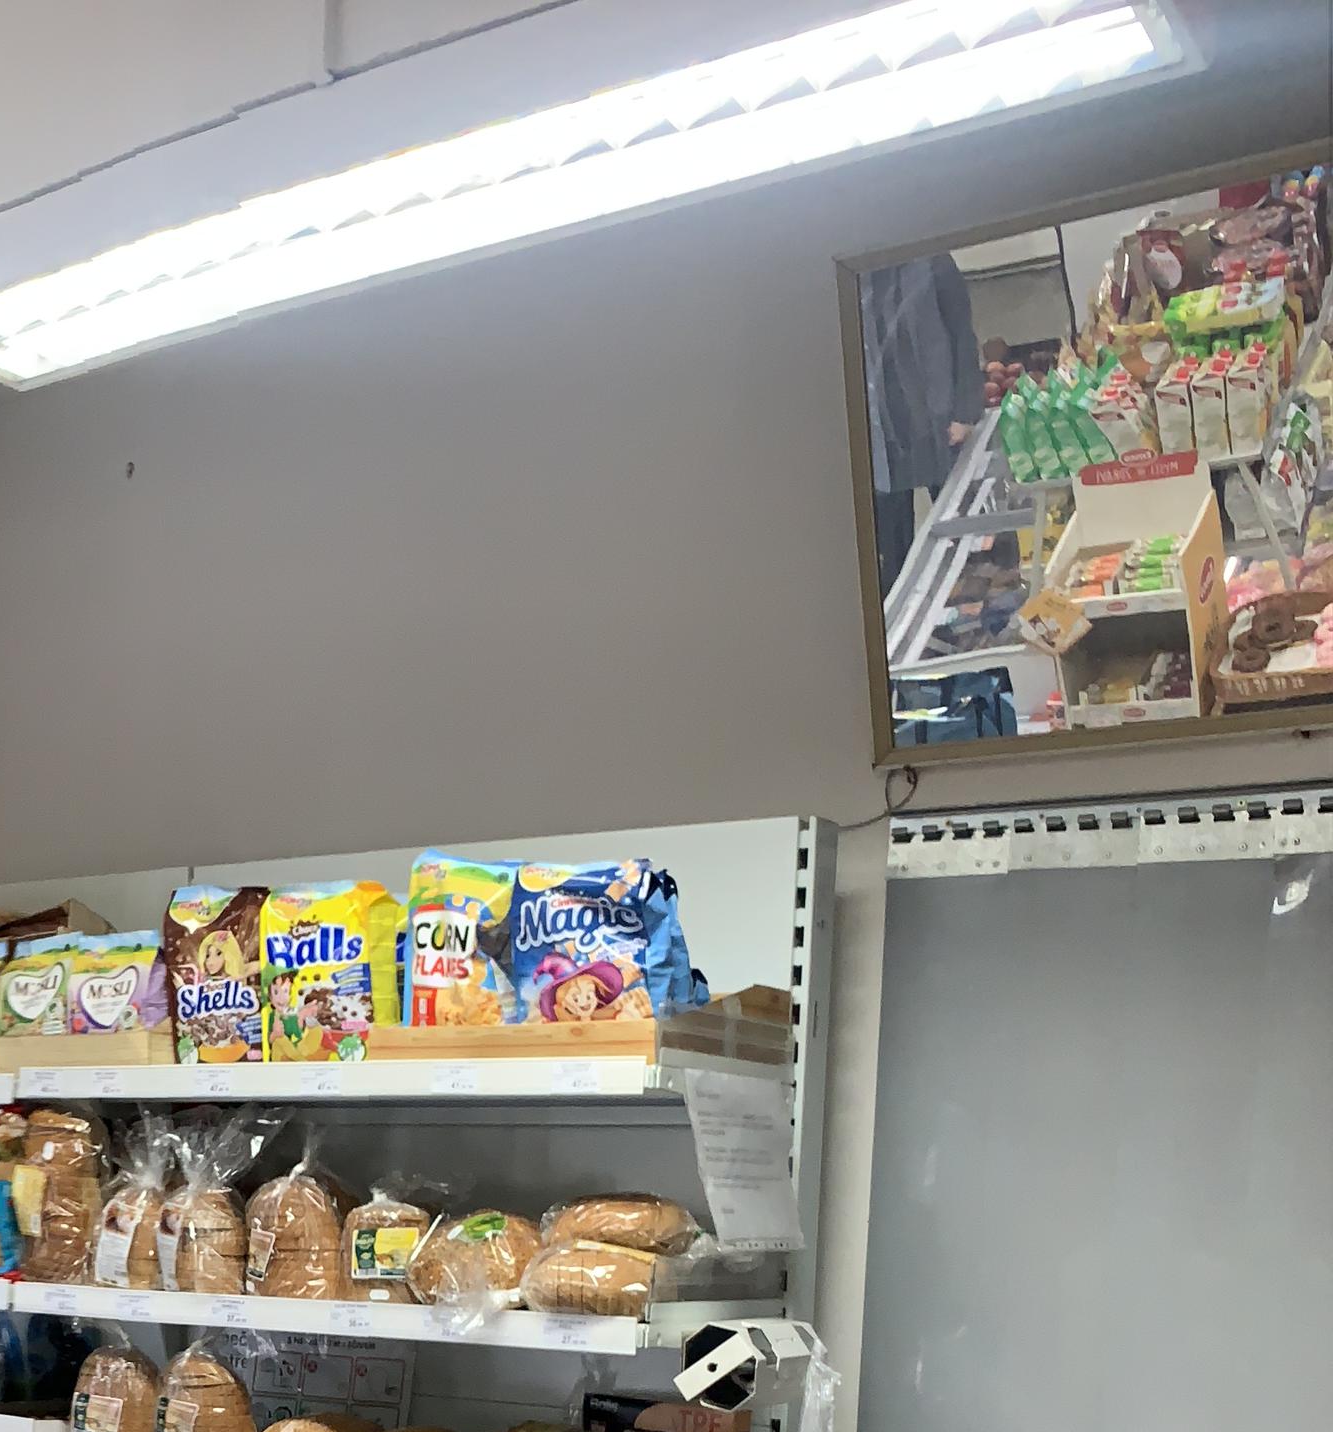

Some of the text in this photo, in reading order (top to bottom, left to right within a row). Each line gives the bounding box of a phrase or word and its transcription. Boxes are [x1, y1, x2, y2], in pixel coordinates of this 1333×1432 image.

[415, 921, 470, 953] CORN
[515, 898, 644, 954] Magic
[180, 981, 255, 1018] Shells
